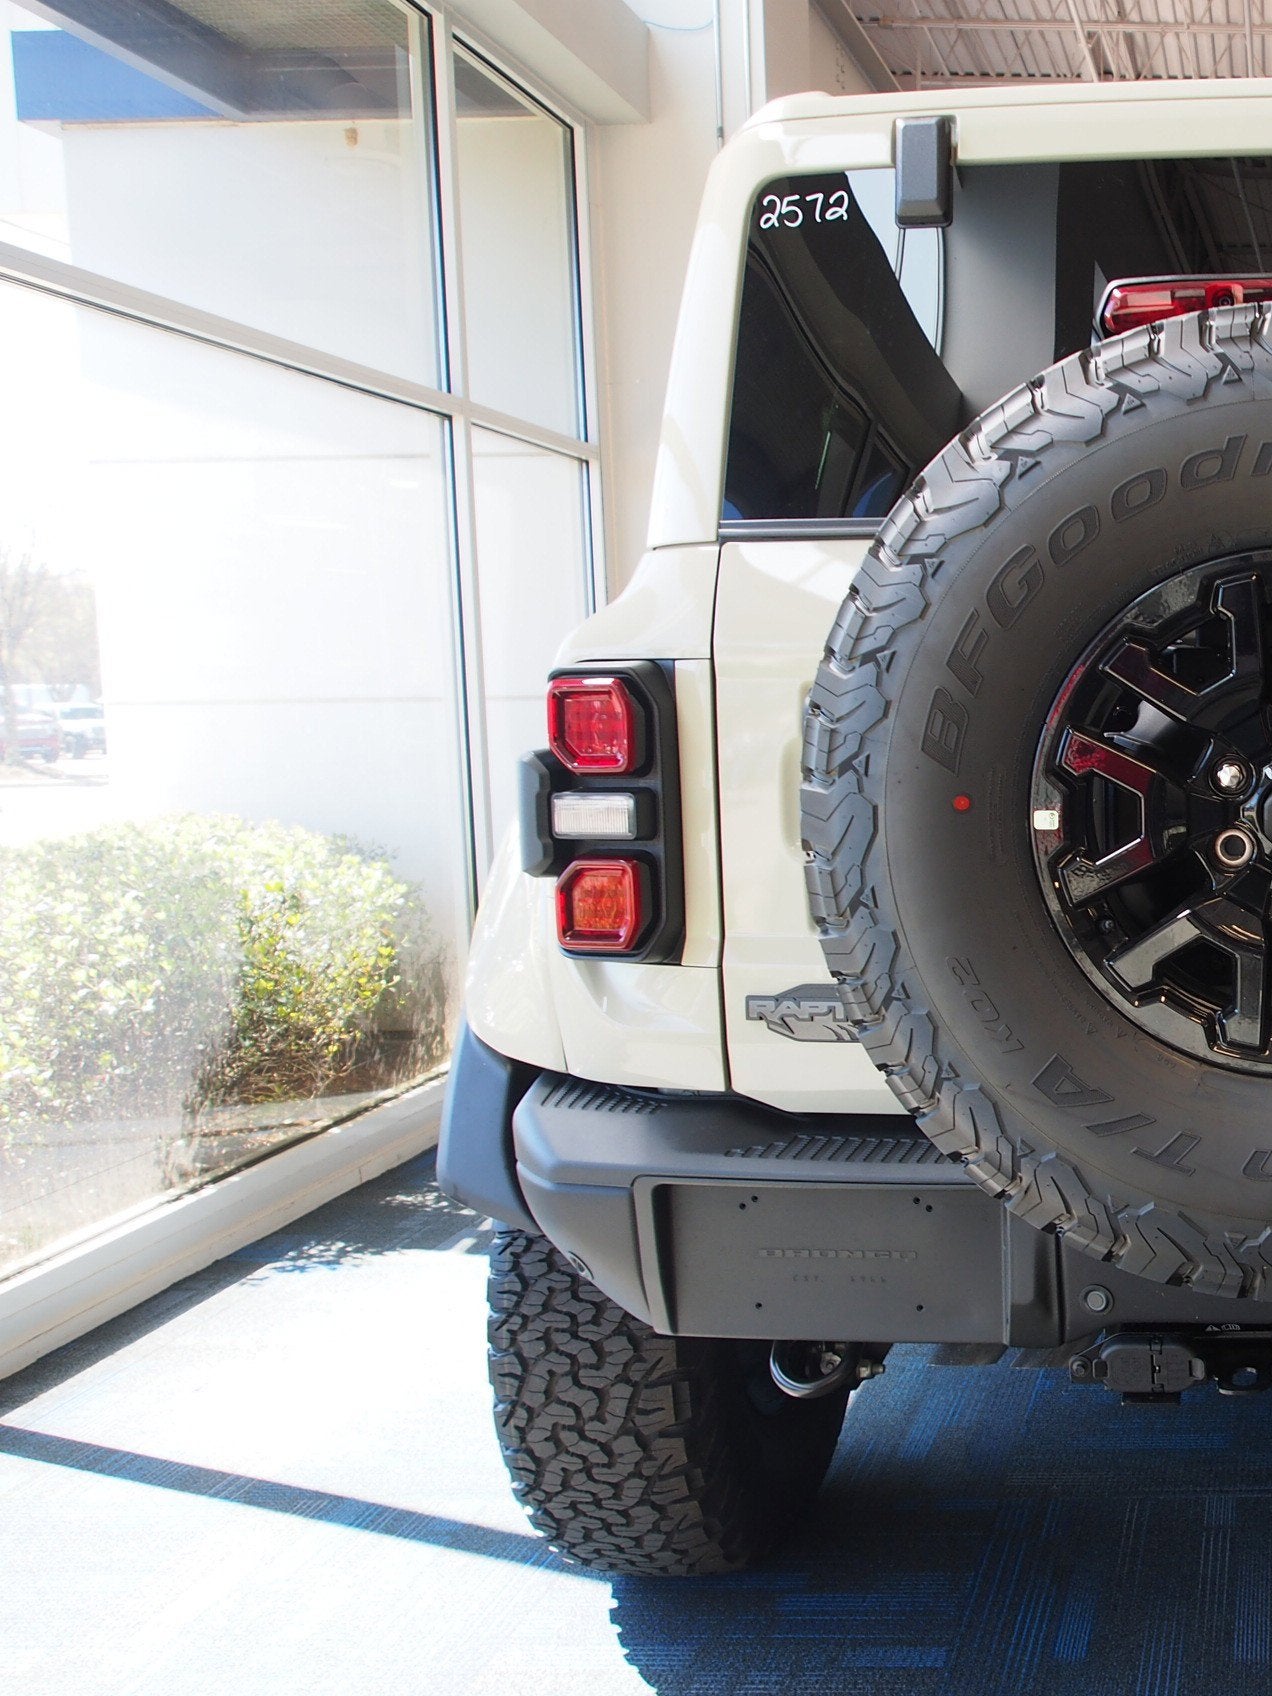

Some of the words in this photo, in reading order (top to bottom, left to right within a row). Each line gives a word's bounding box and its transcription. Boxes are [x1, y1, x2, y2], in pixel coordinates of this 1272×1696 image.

[759, 190, 849, 229] 2572
[1031, 1053, 1201, 1177] T/A
[758, 1249, 917, 1259] BRONCO
